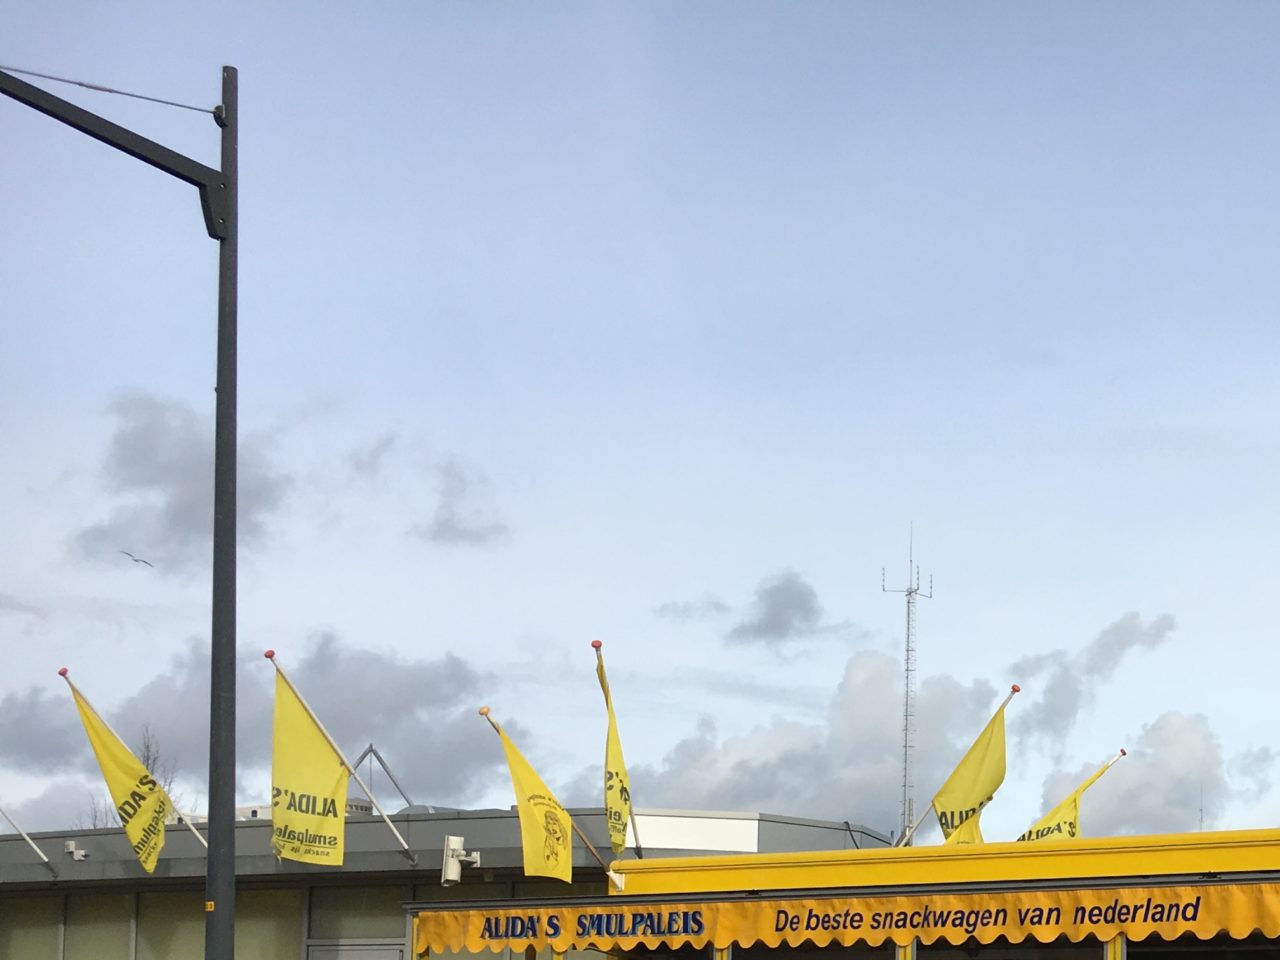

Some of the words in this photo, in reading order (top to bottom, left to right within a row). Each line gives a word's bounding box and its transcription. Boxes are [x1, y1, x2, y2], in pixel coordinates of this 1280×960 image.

[118, 774, 157, 828] IDA'S
[480, 914, 562, 940] ALIDA'S
[576, 909, 705, 939] SMULPALEIS
[774, 910, 800, 932] De
[805, 907, 864, 931] beste
[869, 905, 1008, 934] snackwagen
[1017, 907, 1062, 927] van
[1072, 897, 1201, 926] nederland
